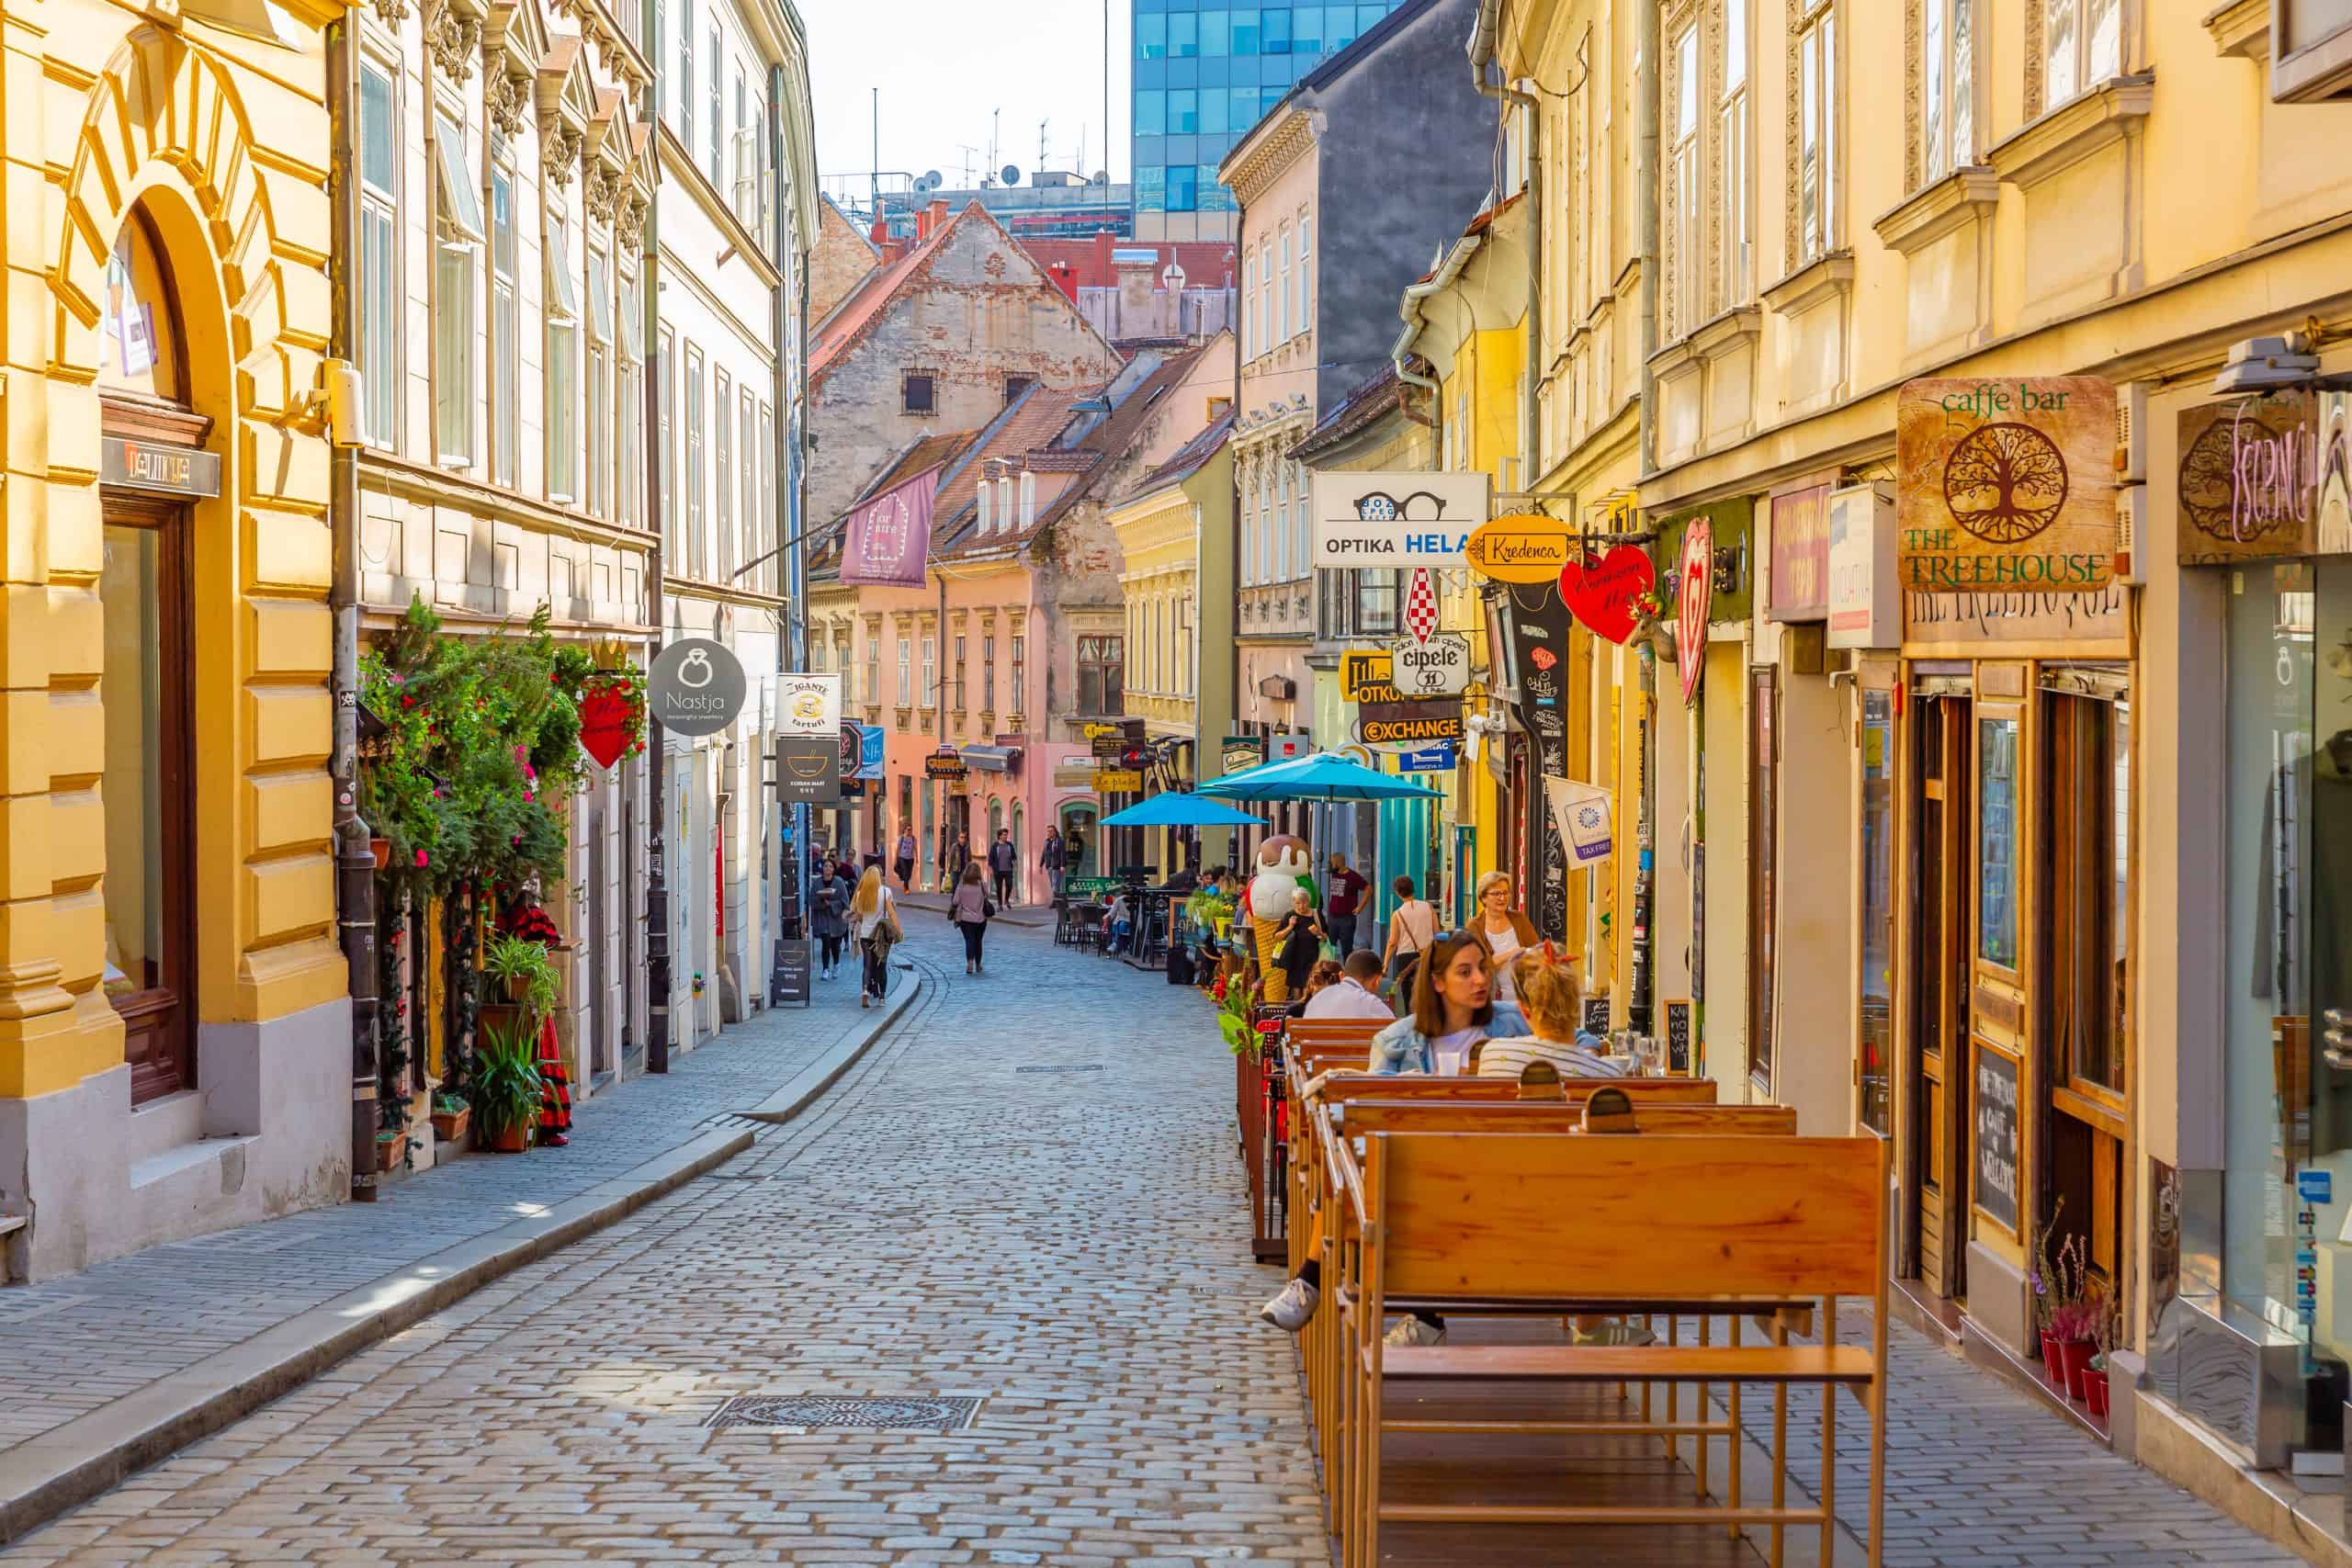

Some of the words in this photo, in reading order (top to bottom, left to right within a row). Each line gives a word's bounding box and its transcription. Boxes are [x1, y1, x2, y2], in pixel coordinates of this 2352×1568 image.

[1941, 383, 2011, 419] caffe
[2020, 384, 2070, 412] bar
[1326, 538, 1396, 553] OPTIKA
[1493, 536, 1561, 562] Kredenca
[1905, 528, 1960, 551] THE
[1905, 553, 2108, 586] TREEHOUSE
[1403, 646, 1458, 674] cipele
[666, 691, 725, 714] Nastja
[1359, 683, 1404, 704] OTKU
[1581, 845, 1594, 856] TAX
